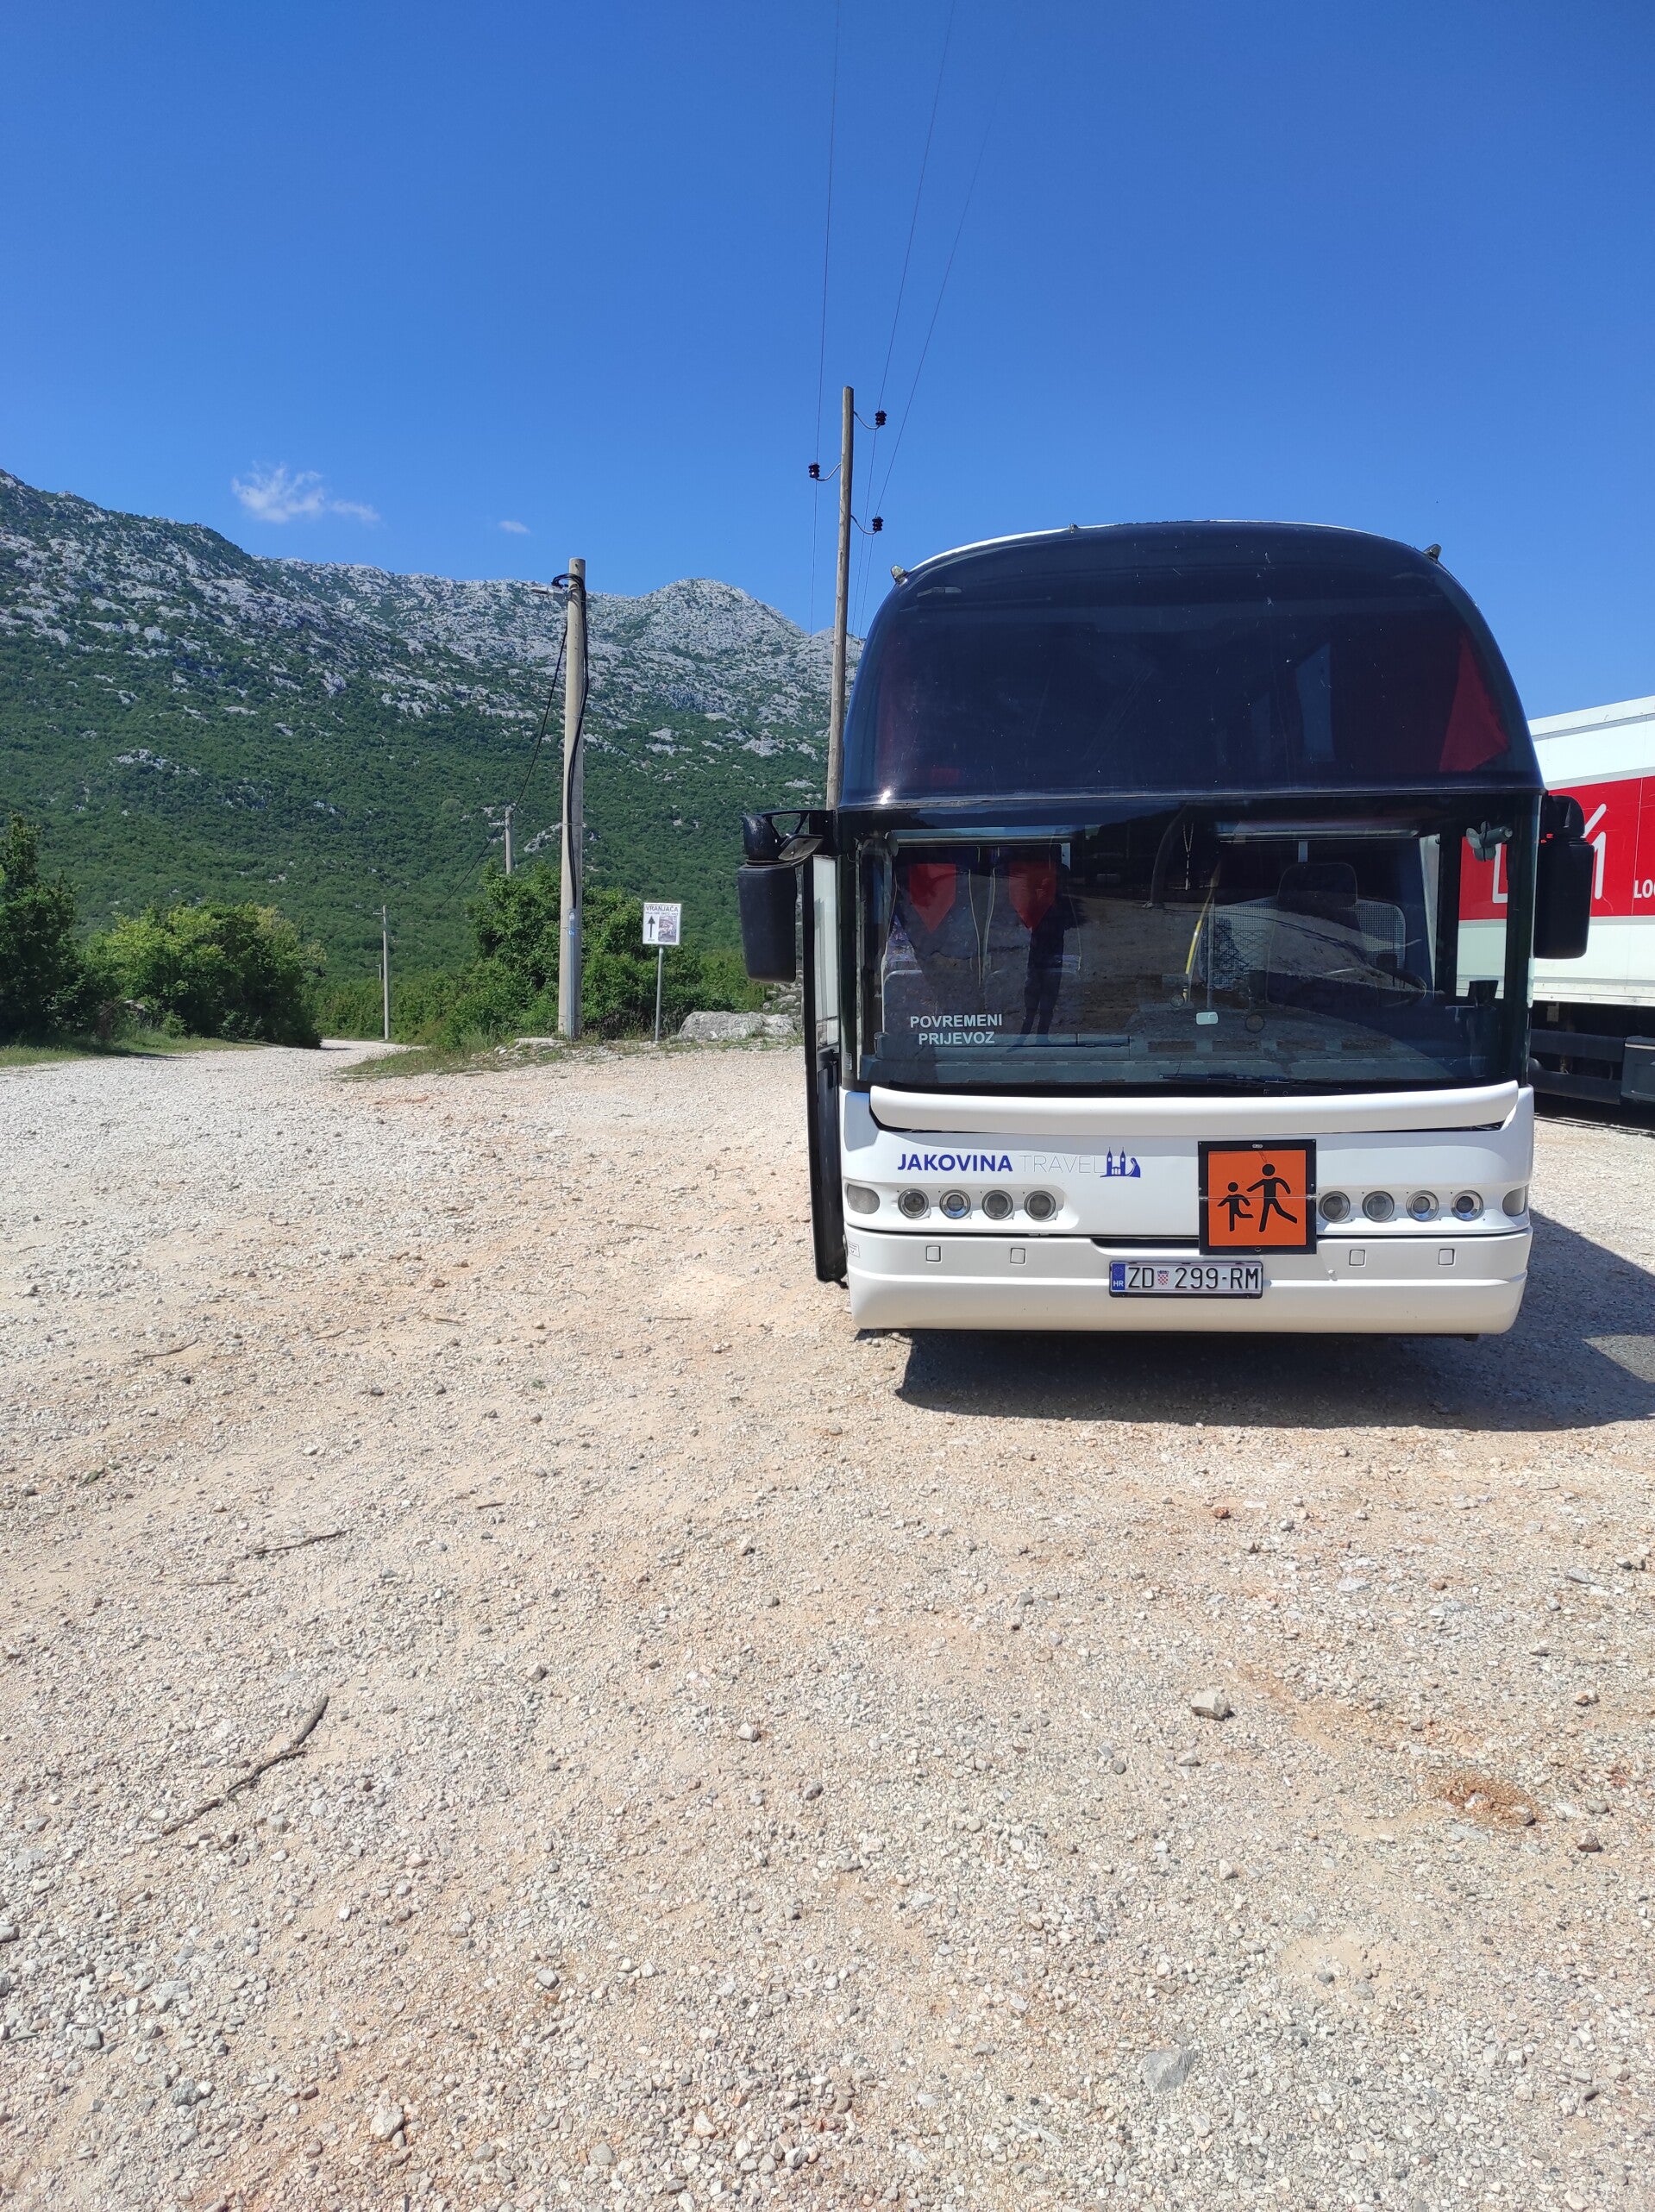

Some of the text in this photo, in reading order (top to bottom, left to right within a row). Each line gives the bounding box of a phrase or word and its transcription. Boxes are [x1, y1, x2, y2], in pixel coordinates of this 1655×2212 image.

[1633, 879, 1655, 899] LO
[910, 1013, 1002, 1028] POVREMENI
[918, 1031, 995, 1045] PRIJEVOZ
[897, 1154, 1106, 1174] JAKOVINA TRAVEL
[1127, 1267, 1259, 1289] ZD 299-RM
